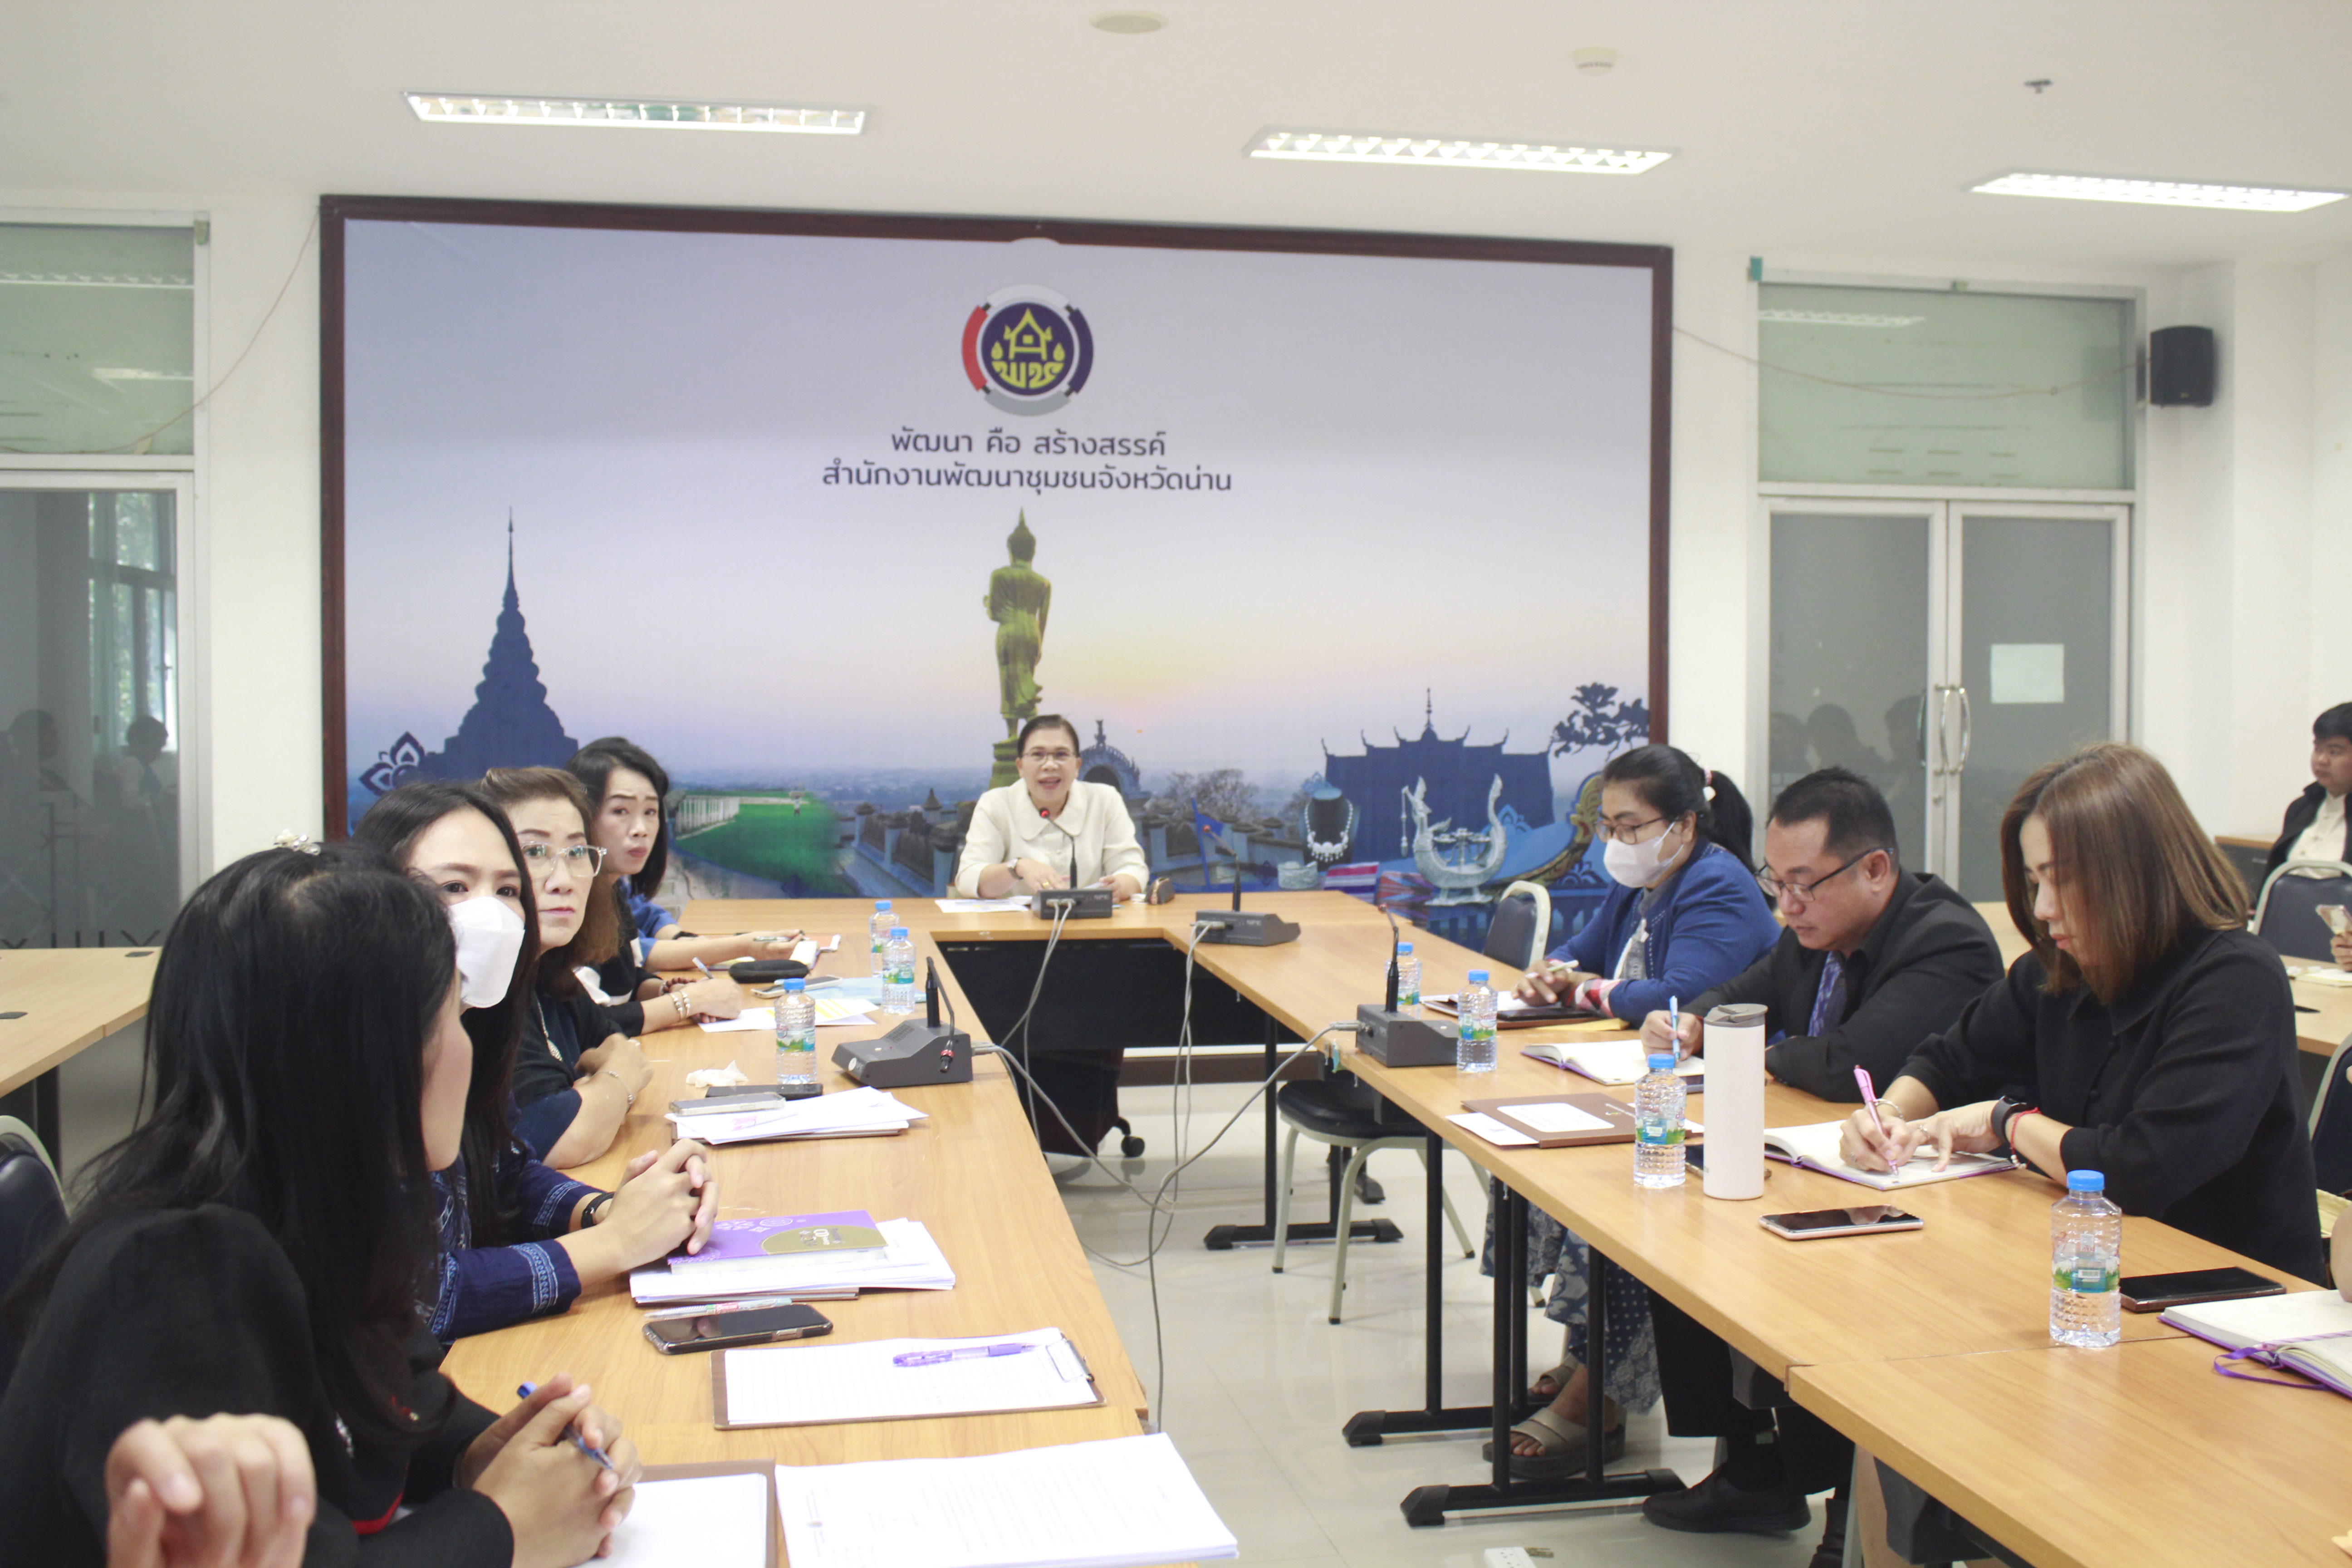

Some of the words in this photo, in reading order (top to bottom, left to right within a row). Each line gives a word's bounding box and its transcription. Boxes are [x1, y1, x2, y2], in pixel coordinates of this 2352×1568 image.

[892, 426, 972, 453] พัฒนา
[987, 427, 1020, 454] คือ
[1034, 428, 1166, 456] สร้างสรรค์
[822, 457, 1231, 495] สำนักงานพัฒนาชุมชนจังหวัดน่าน
